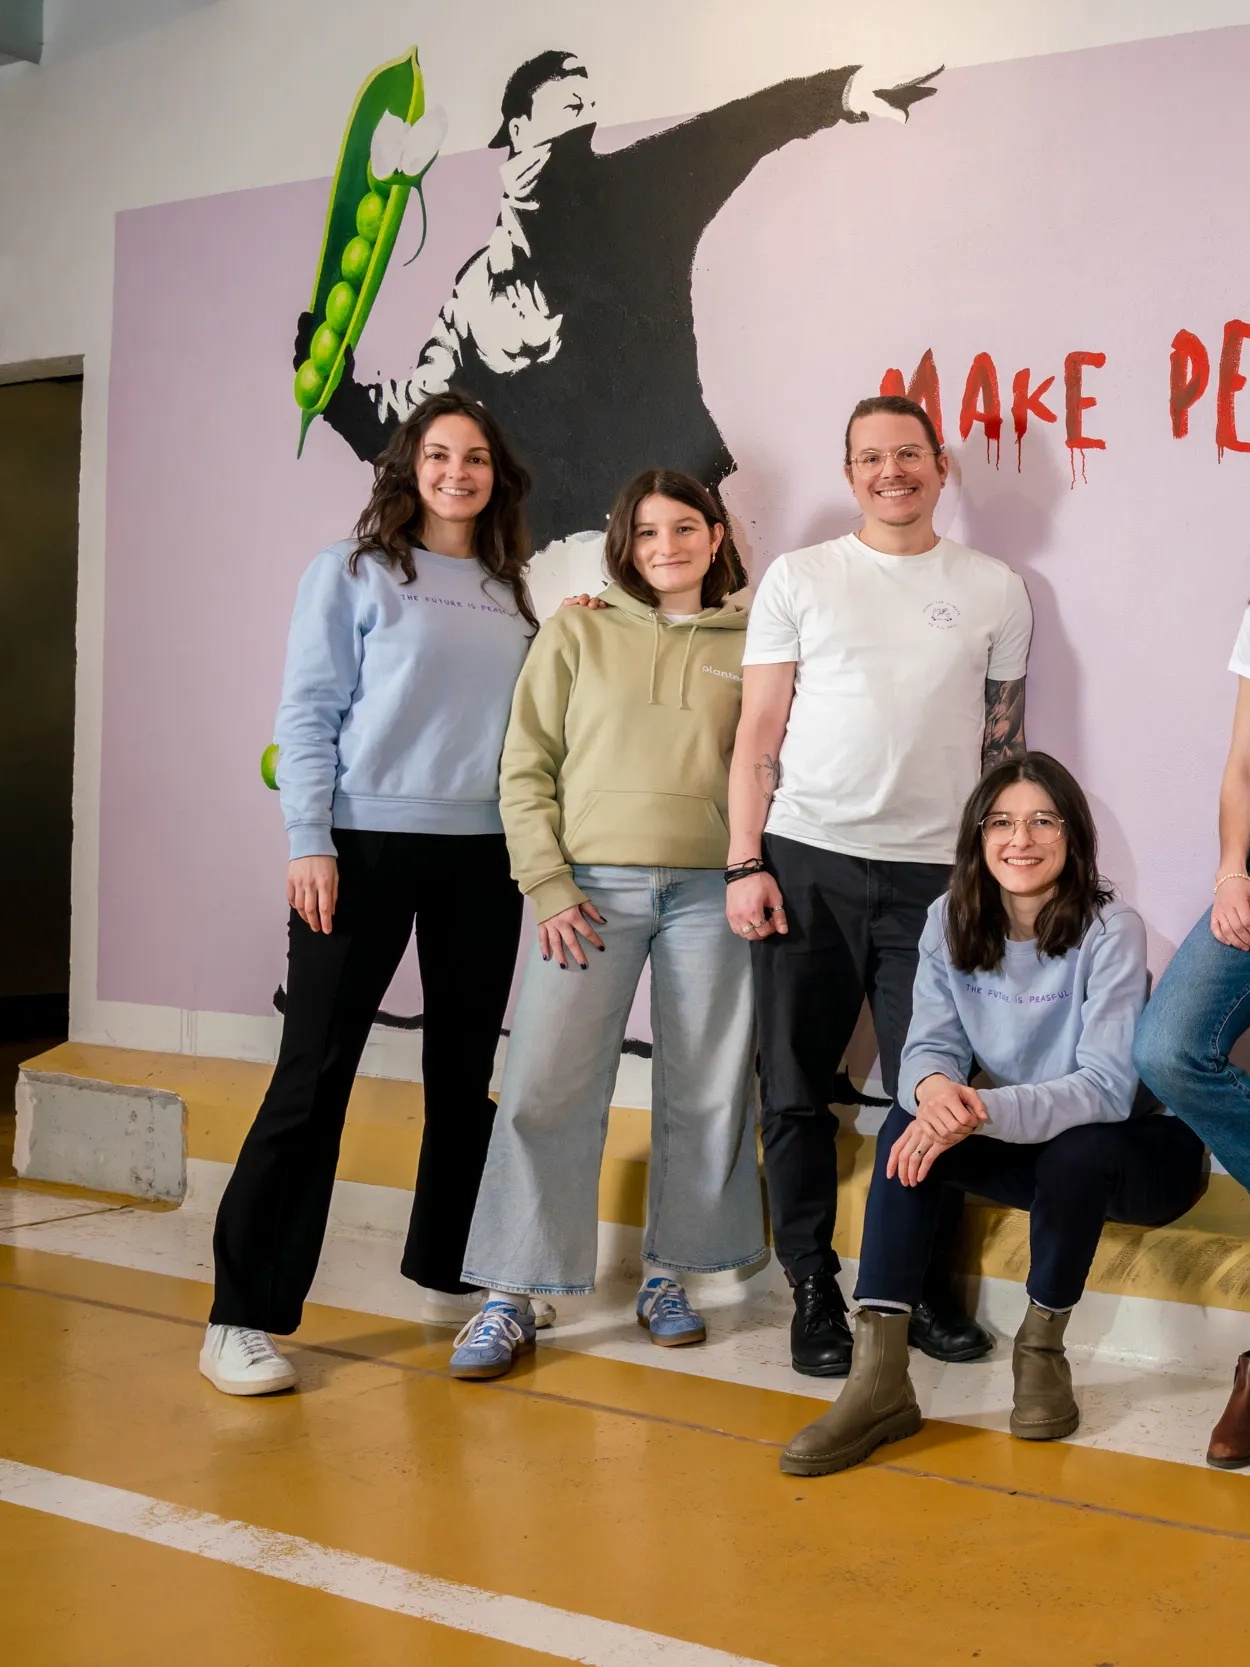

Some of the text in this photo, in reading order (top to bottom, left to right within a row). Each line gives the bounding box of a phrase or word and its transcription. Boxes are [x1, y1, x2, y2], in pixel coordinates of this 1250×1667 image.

[400, 594, 421, 602] THE
[425, 596, 463, 608] FUTURE
[467, 602, 477, 610] IS
[965, 983, 983, 995] THE
[1014, 996, 1023, 1005] IS
